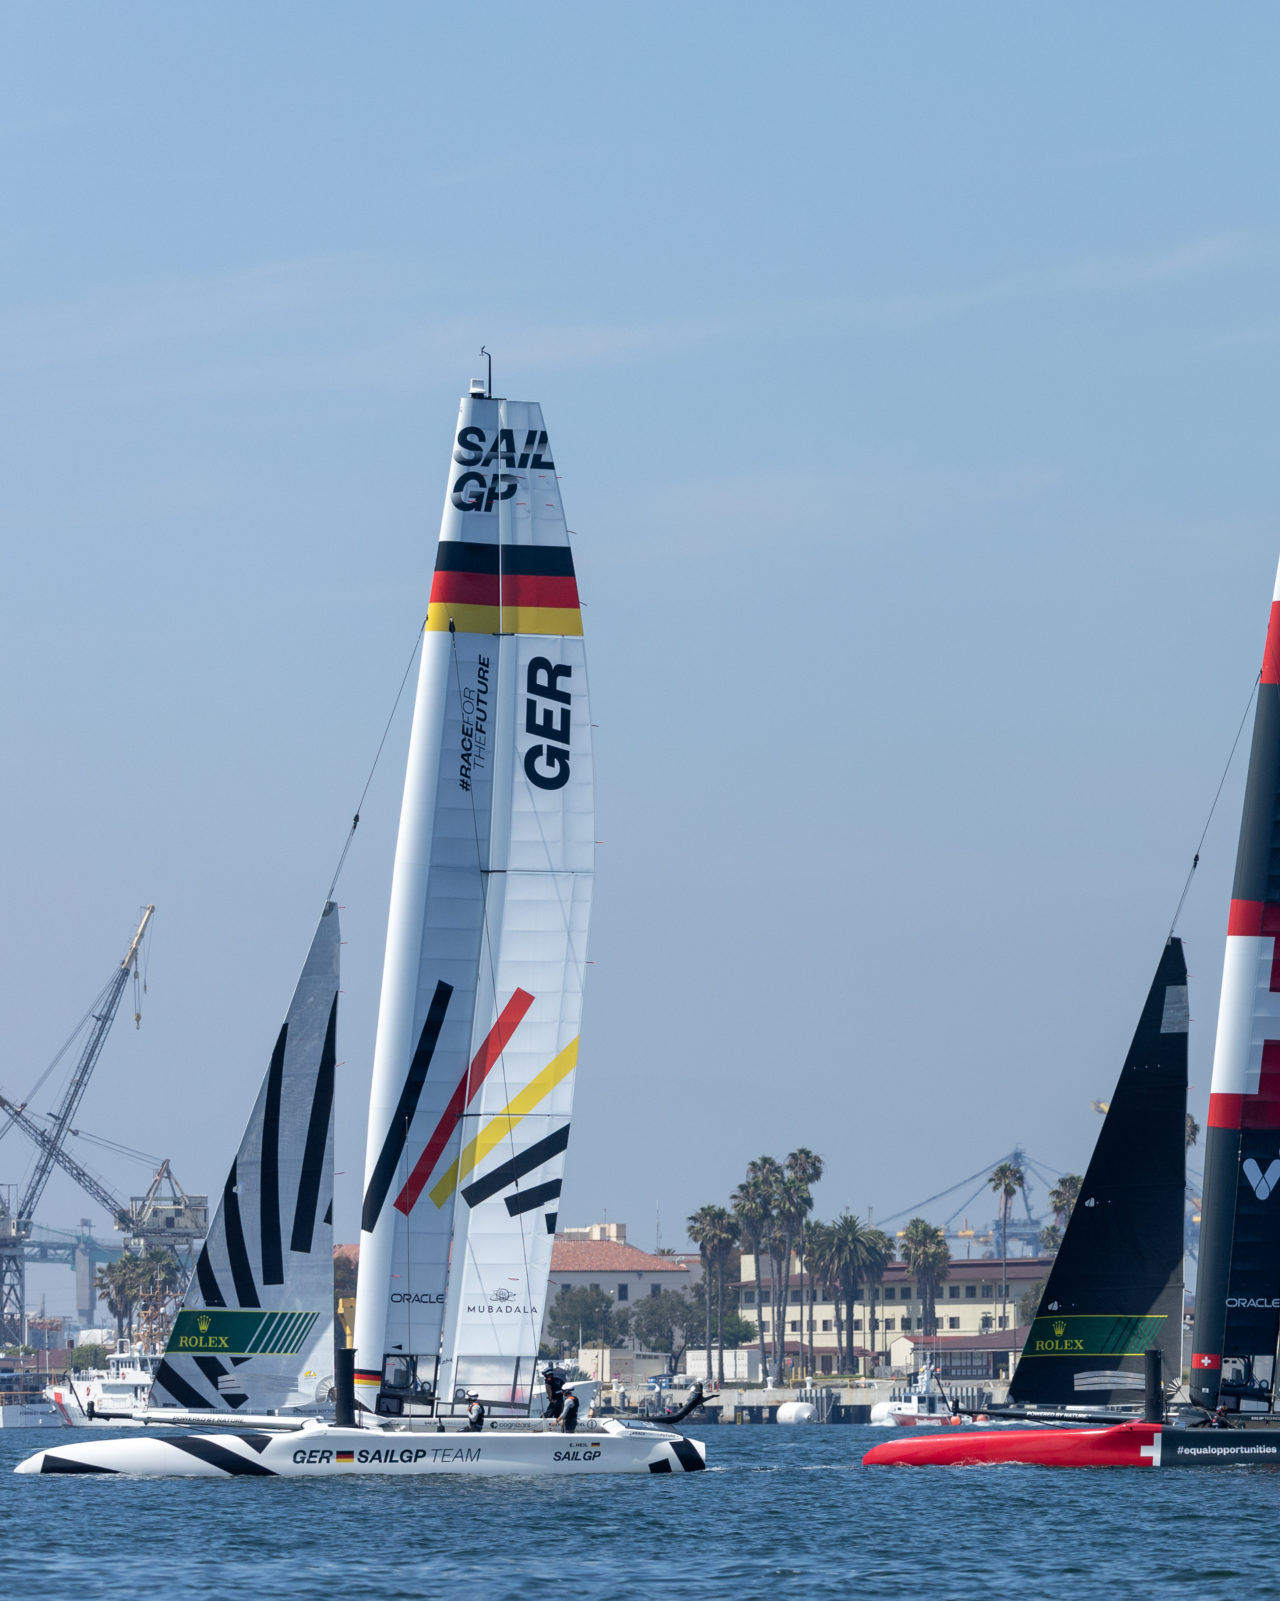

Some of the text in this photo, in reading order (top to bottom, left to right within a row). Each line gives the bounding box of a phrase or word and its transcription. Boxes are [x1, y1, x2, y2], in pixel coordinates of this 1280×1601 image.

[452, 426, 556, 470] SAIL
[451, 471, 518, 512] GP
[524, 656, 573, 791] GER
[390, 1293, 445, 1304] ORACLE
[1225, 1298, 1280, 1308] ORACLE
[467, 1305, 538, 1314] MUBADALA
[178, 1335, 229, 1348] ROLEX
[1035, 1339, 1084, 1350] ROLEX
[292, 1449, 333, 1464] GER
[431, 1448, 482, 1463] TEAM
[1177, 1444, 1278, 1456] #equalopportunities
